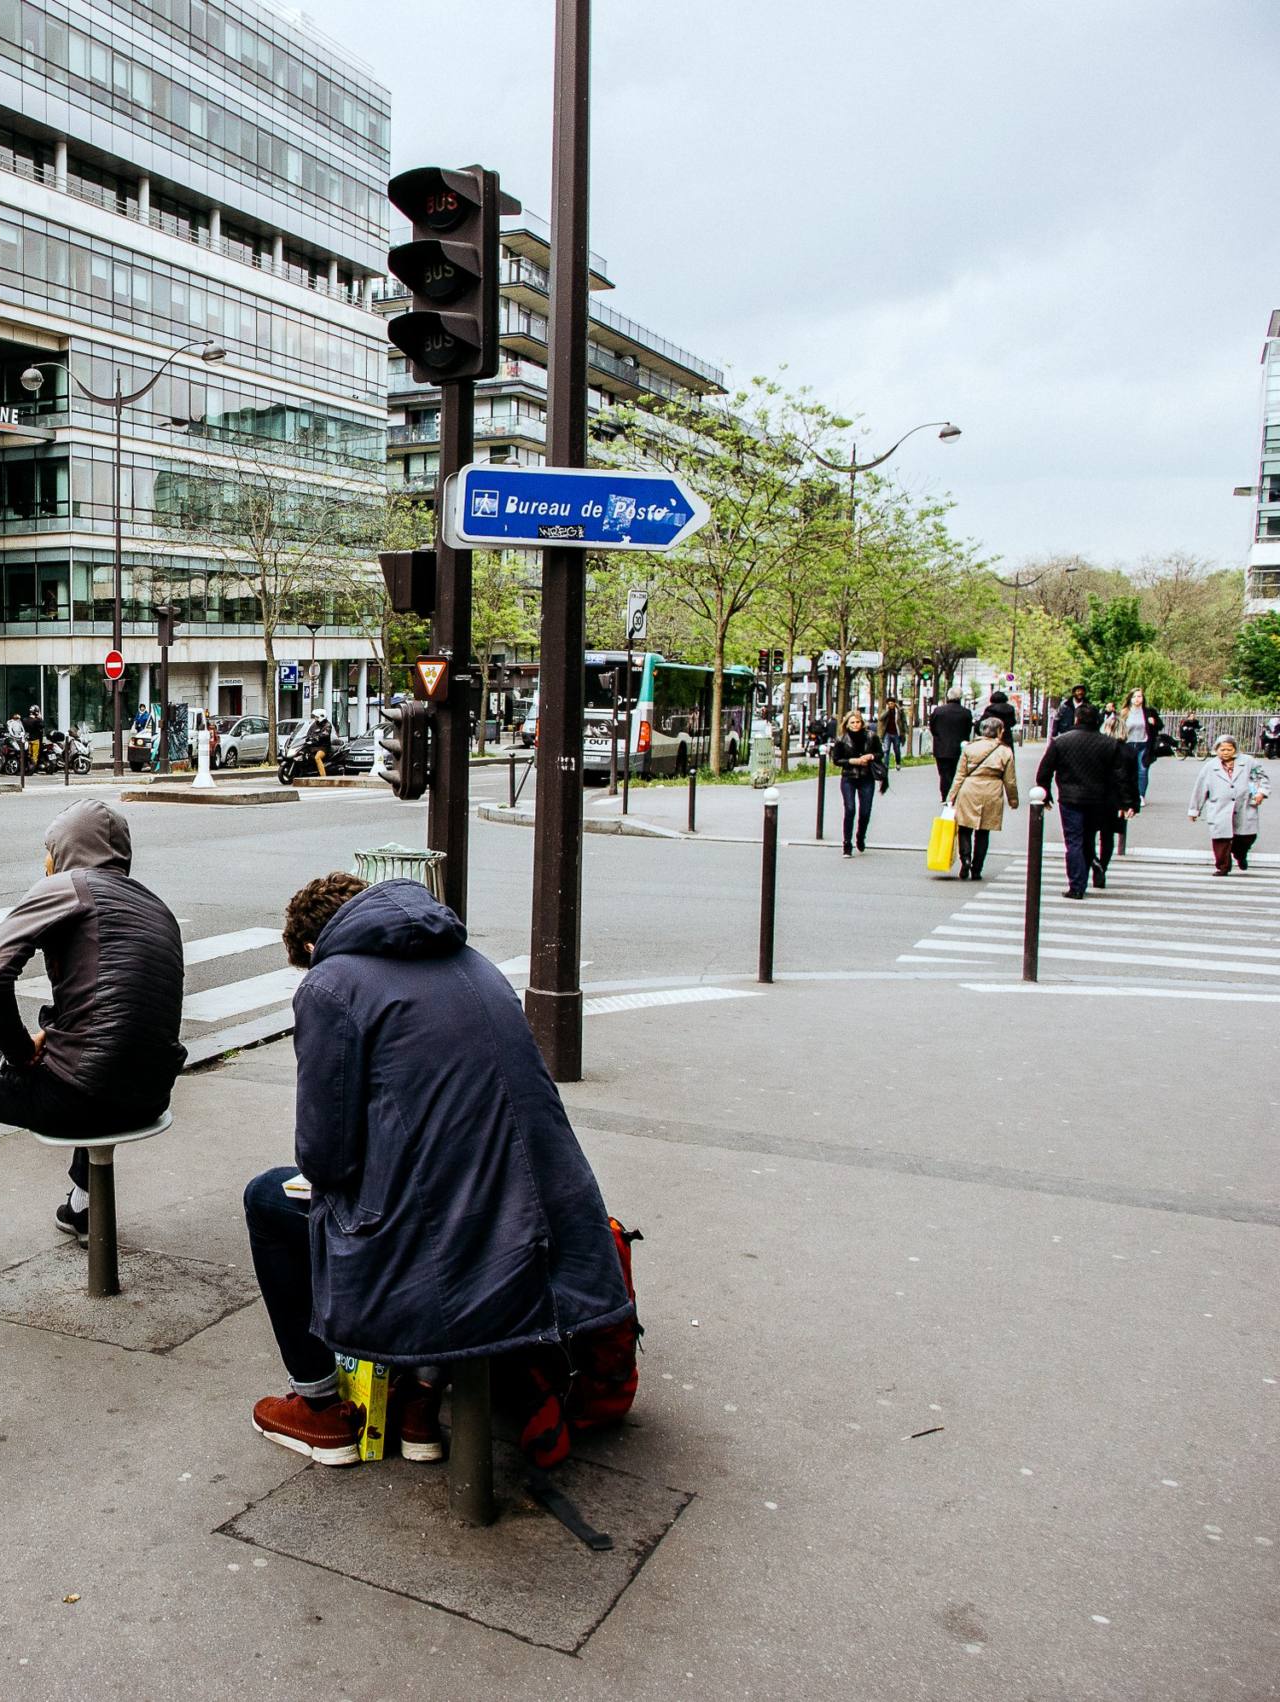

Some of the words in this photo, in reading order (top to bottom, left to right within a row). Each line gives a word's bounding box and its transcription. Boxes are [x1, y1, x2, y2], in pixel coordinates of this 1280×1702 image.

[426, 193, 458, 214] BUS
[505, 496, 570, 516] Bureau
[581, 500, 603, 518] de
[281, 667, 290, 679] P
